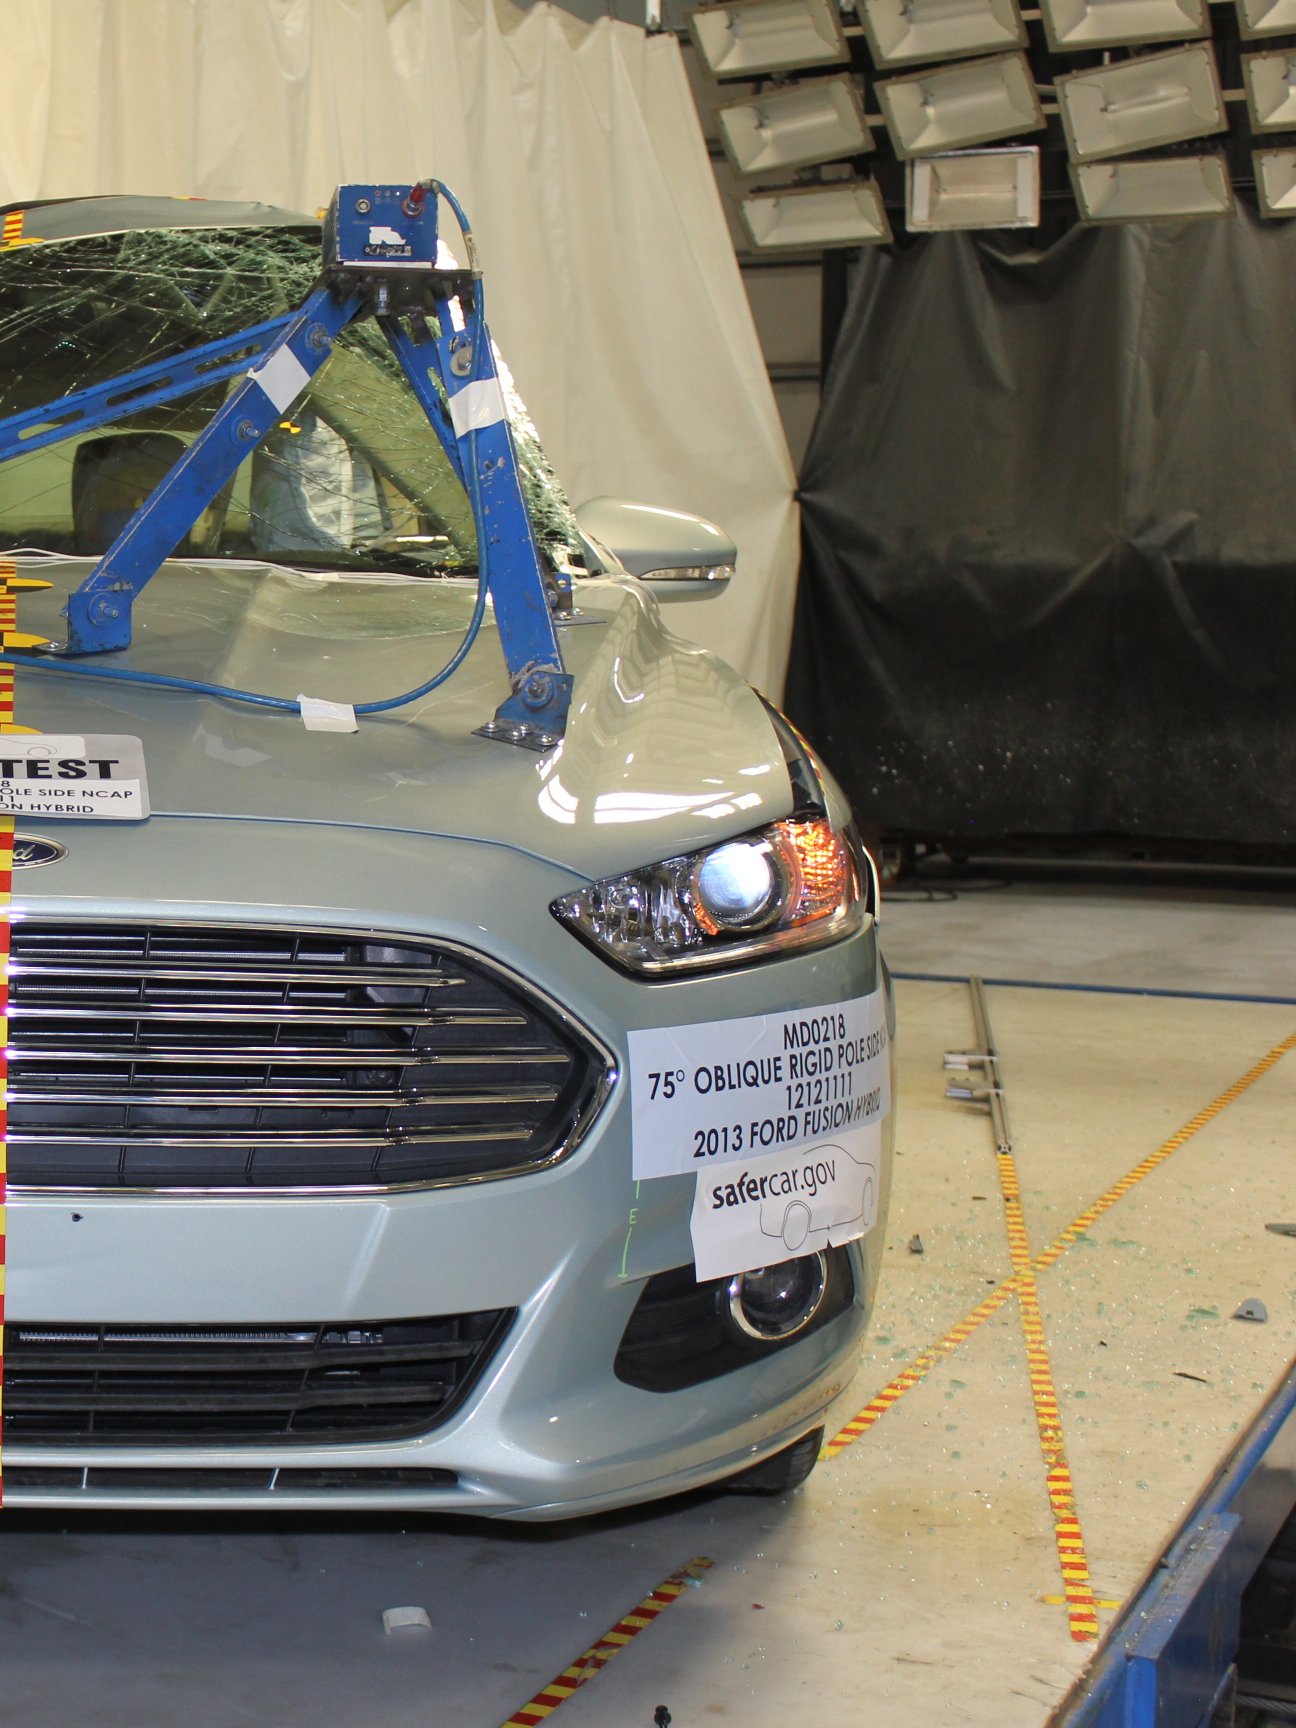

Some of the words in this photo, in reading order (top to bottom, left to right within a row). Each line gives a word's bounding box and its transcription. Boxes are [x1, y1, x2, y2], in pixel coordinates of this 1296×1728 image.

[30, 803, 95, 813] HYBRID
[38, 788, 76, 797] SIDE
[81, 790, 134, 799] NCAP
[783, 1013, 846, 1050] MD0218
[647, 1069, 686, 1101] 75°
[693, 1056, 783, 1095] OBLIQUE
[788, 1046, 834, 1080] RIGID
[837, 1037, 865, 1069] POLE
[866, 1030, 880, 1060] SIDE
[785, 1070, 852, 1111] 12121111
[692, 1123, 744, 1158] 2013
[749, 1114, 798, 1149] FORD
[802, 1098, 854, 1138] FUSION
[711, 1159, 837, 1210] safercar.gov
